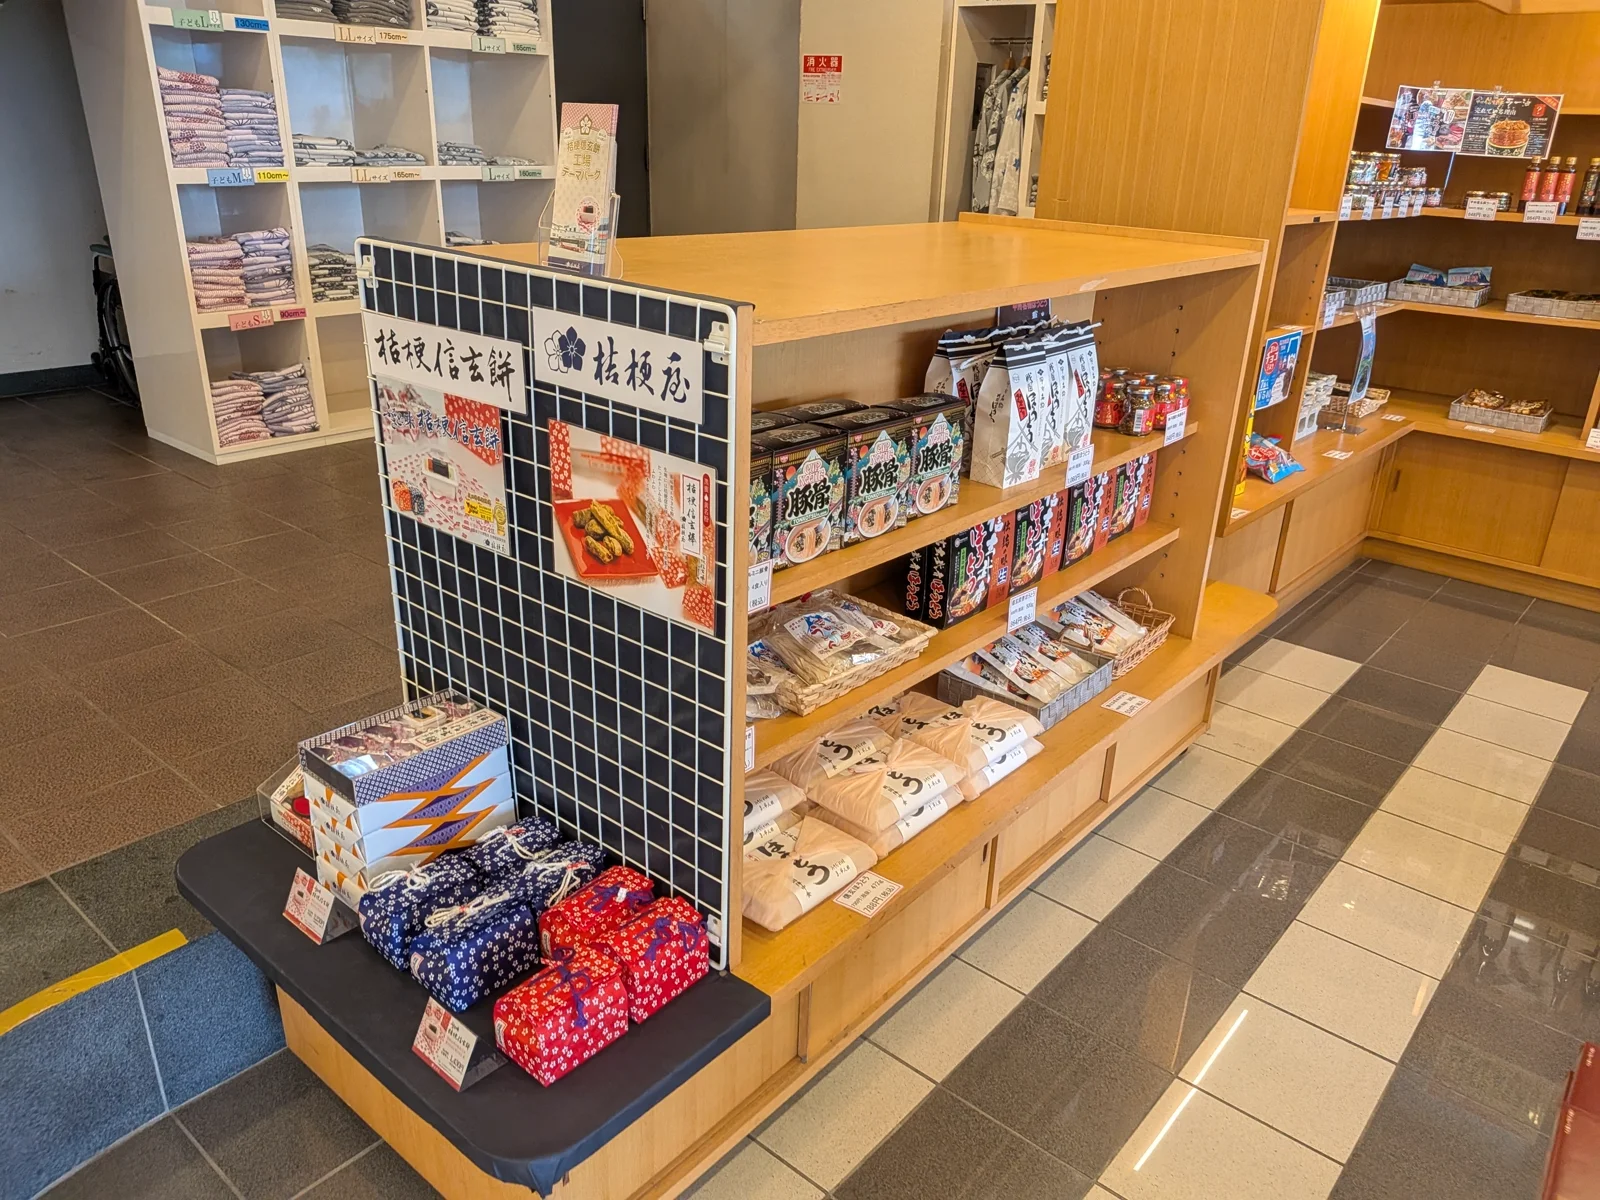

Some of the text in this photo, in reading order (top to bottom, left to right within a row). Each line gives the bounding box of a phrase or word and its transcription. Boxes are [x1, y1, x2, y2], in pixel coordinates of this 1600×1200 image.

[338, 27, 373, 42] LLサイズ
[806, 56, 839, 67] 消火器
[355, 169, 389, 182] LLサイズ
[561, 167, 601, 182] テーマパーク
[573, 153, 591, 168] 工場
[374, 328, 516, 402] 桔梗信玄餅
[592, 336, 691, 404] 桔梗屋
[417, 410, 501, 459] 桔梗信玄餅
[919, 438, 953, 473] 豚骨
[860, 457, 899, 494] 豚骨
[686, 482, 697, 547] 桔梗信玄棒
[788, 477, 831, 518] 豚骨
[906, 570, 922, 611] ほうとう
[929, 578, 945, 620] ほうとう
[843, 875, 870, 899] 信玄ほうとう
[862, 885, 895, 913] 788円(税込)
